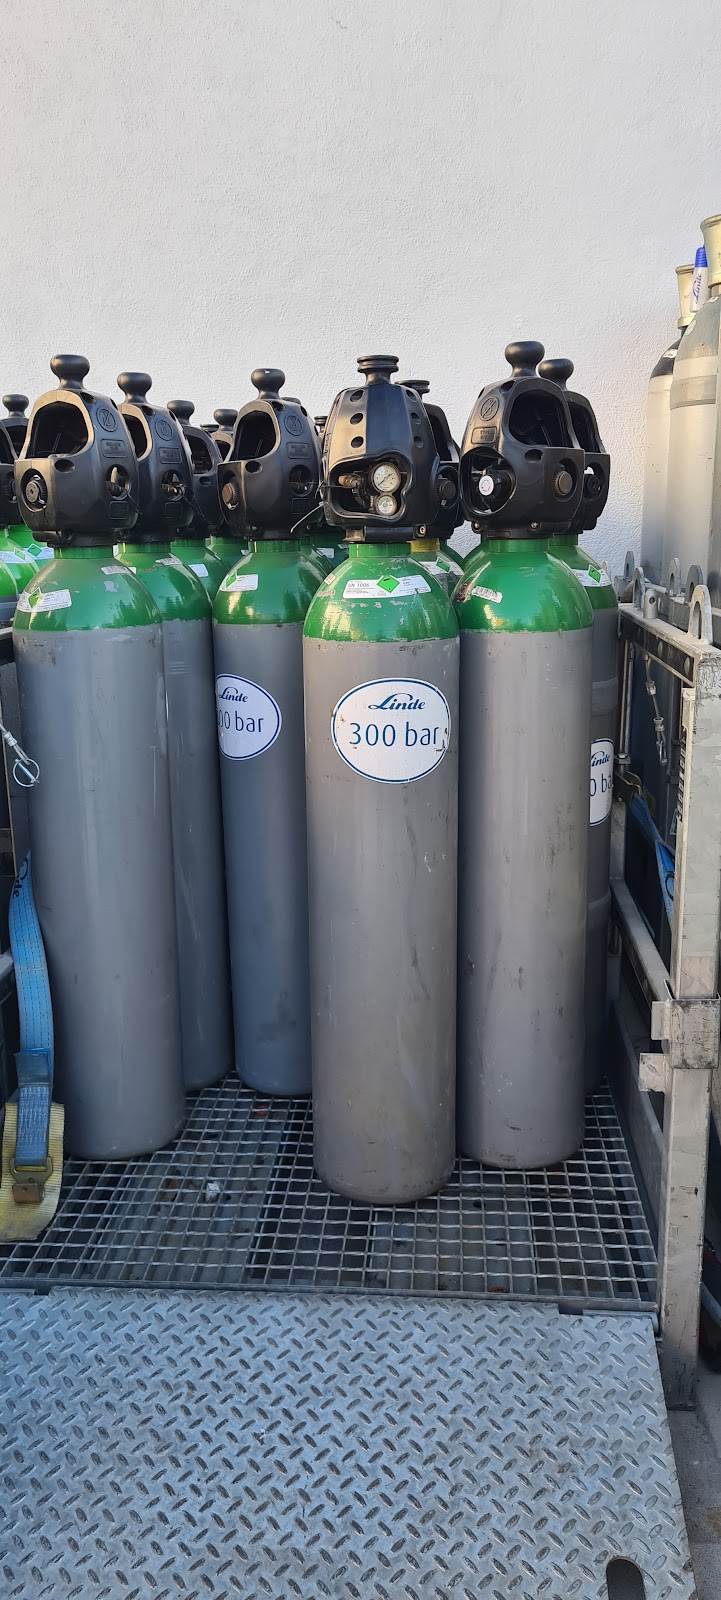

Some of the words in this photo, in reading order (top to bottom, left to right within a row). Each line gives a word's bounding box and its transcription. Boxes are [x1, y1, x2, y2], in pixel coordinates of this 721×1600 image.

[219, 687, 248, 702] Linde
[368, 692, 427, 711] Linde
[217, 709, 231, 730] 00
[235, 710, 265, 733] bar
[349, 721, 397, 747] 300
[405, 721, 440, 747] bar
[602, 773, 612, 792] ba
